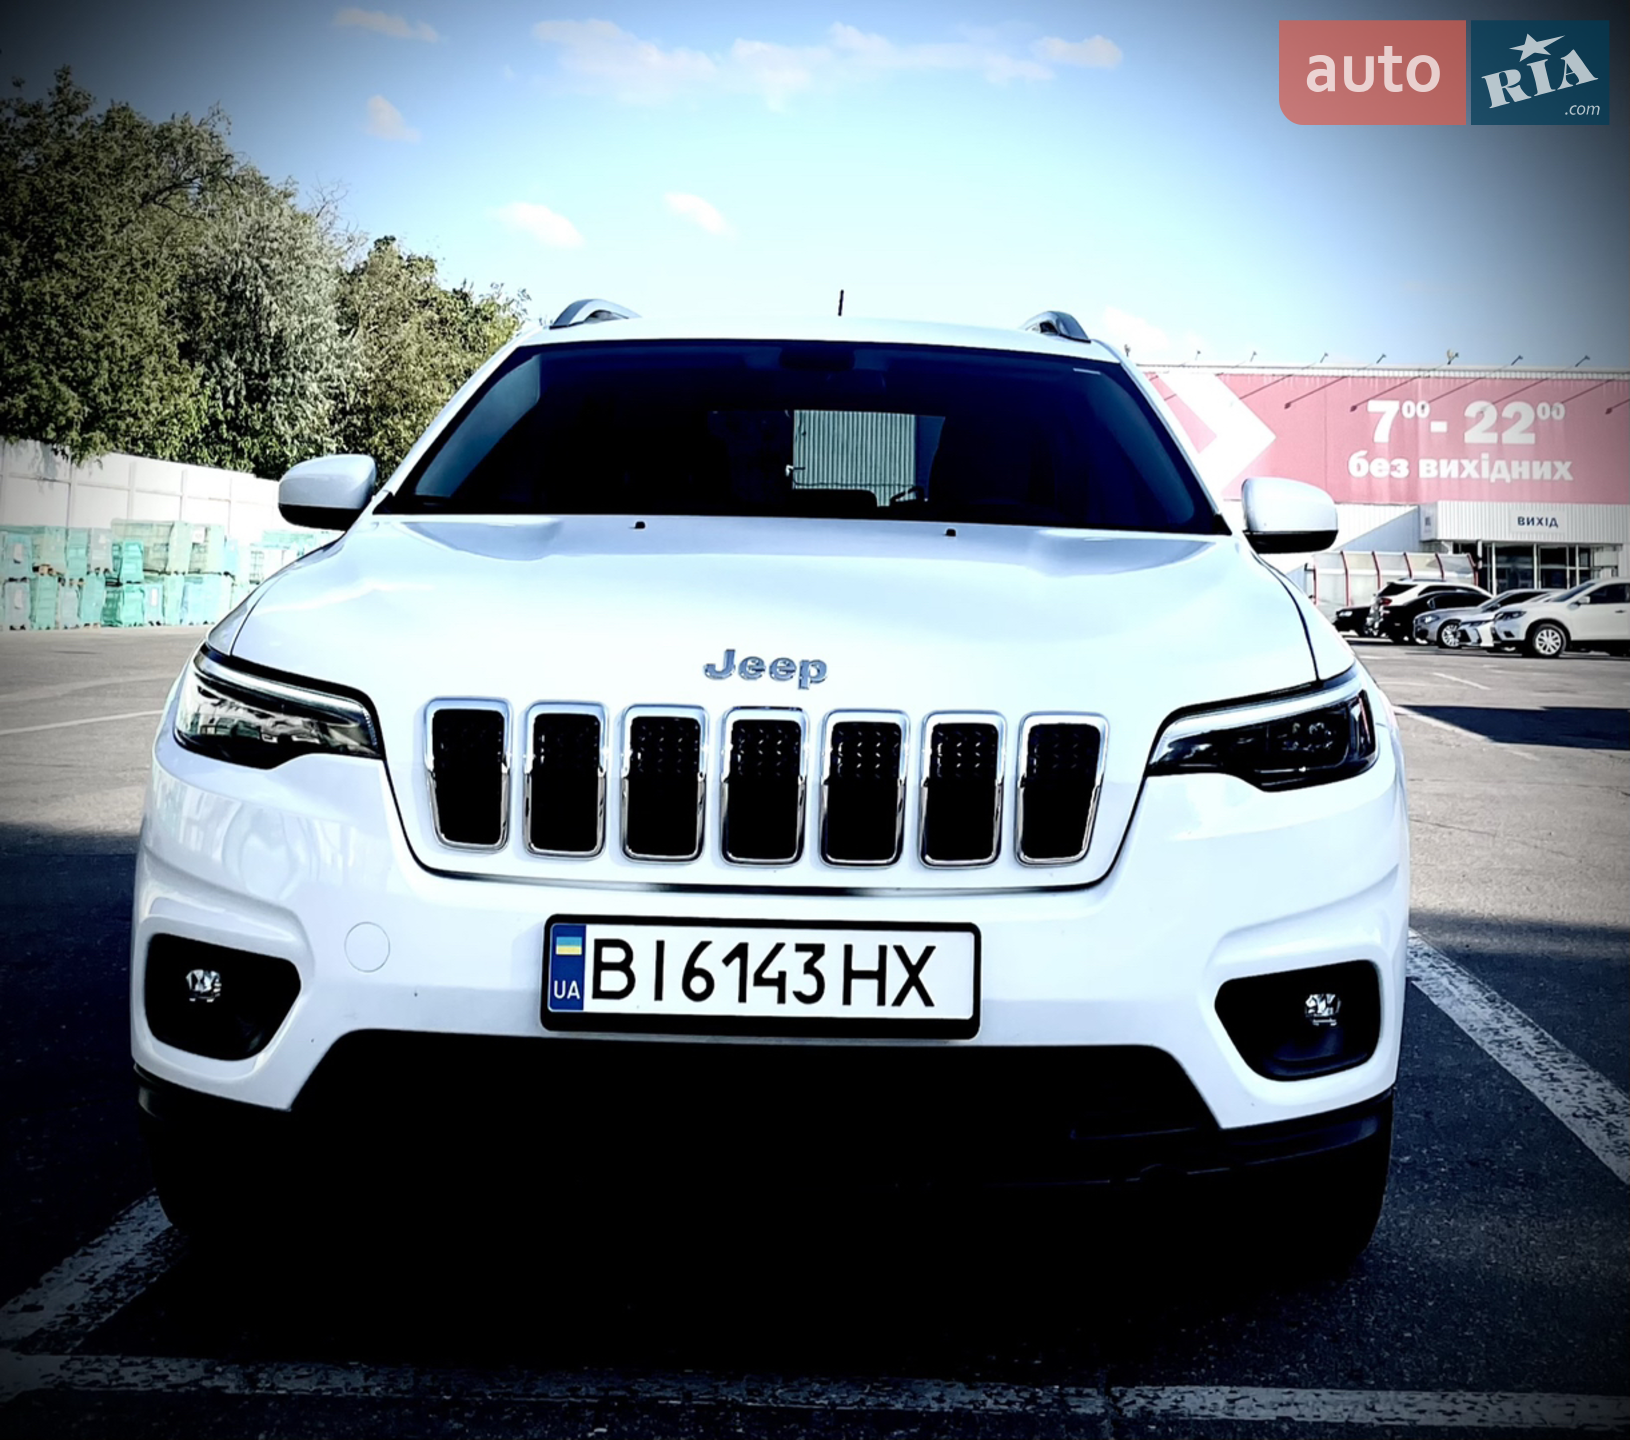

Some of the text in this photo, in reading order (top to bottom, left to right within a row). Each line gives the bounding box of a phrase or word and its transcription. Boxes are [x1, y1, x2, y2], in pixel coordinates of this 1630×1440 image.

[1348, 450, 1573, 483] без вихідних
[1517, 515, 1559, 528] ВИХІД
[703, 649, 828, 690] Jeep
[553, 980, 580, 1000] UA
